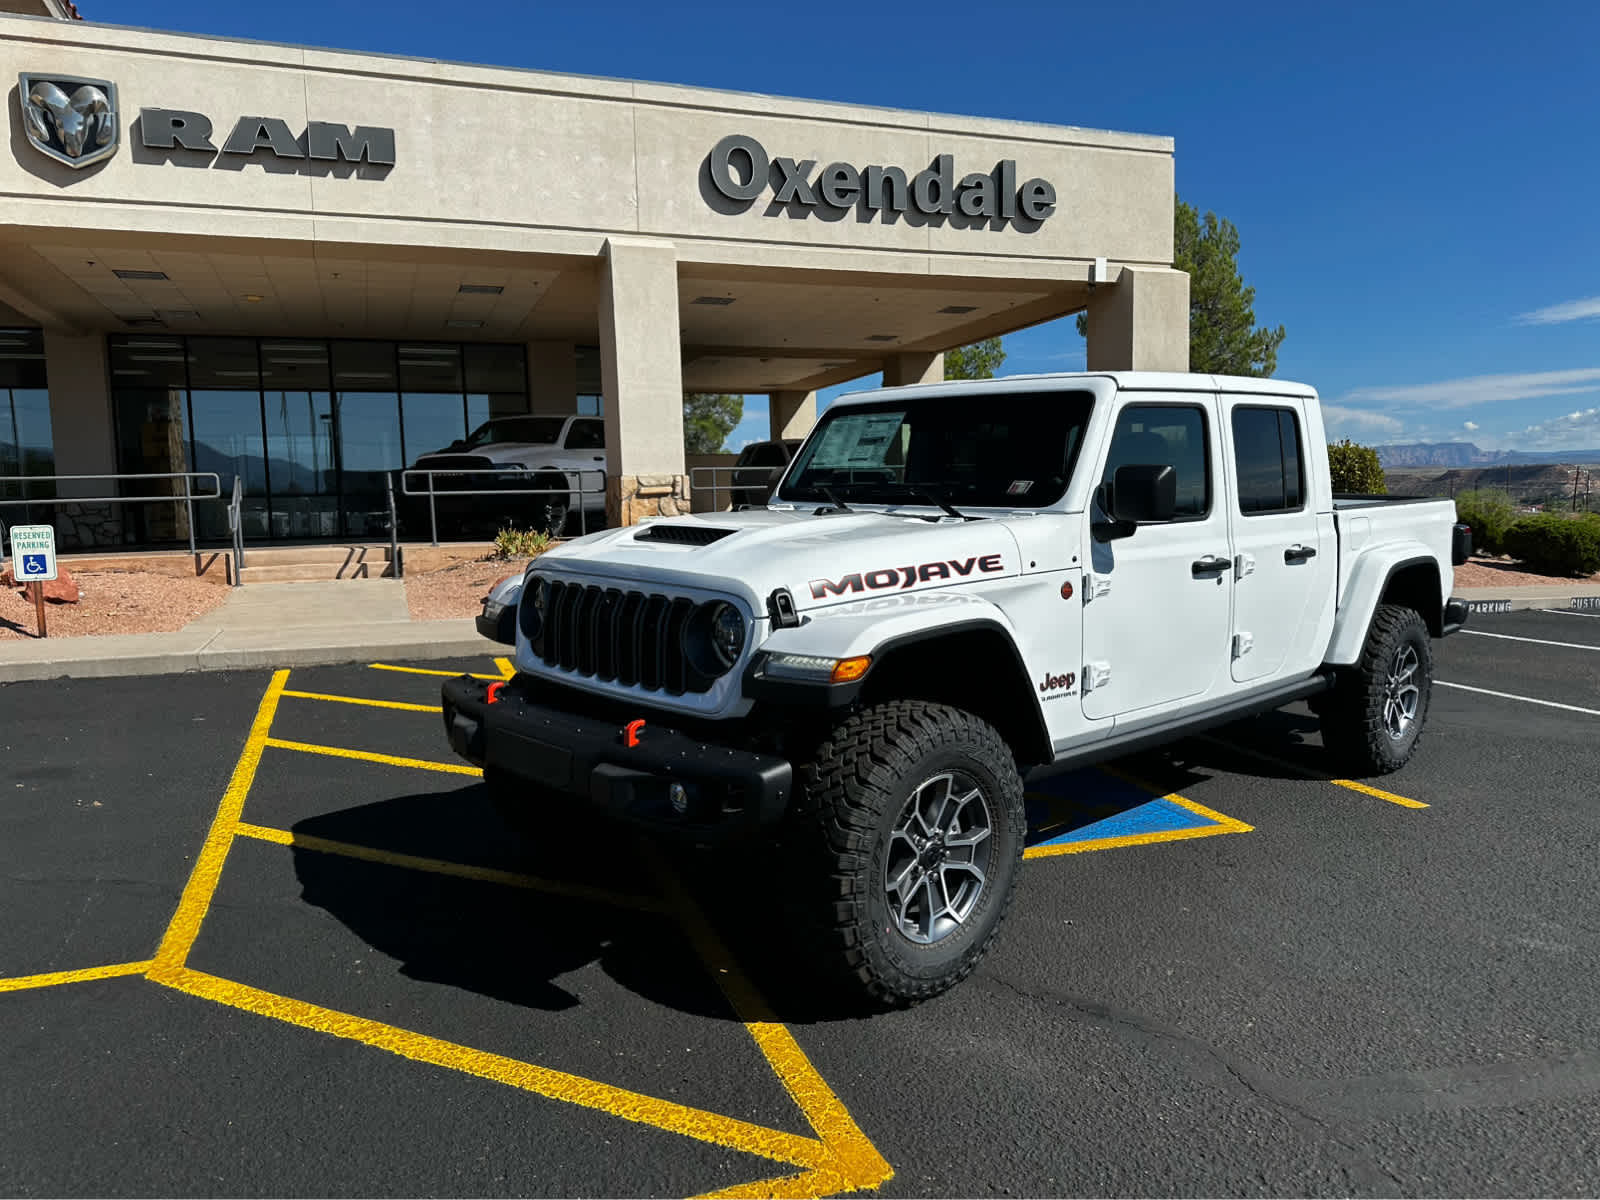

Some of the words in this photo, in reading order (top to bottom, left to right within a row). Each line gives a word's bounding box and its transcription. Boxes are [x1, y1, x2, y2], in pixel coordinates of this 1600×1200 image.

[140, 107, 395, 165] RAM
[710, 134, 1057, 220] Oxendale
[13, 531, 51, 540] RESERVED
[17, 541, 50, 550] PARKING
[808, 553, 1004, 600] MOJAVE
[1468, 602, 1512, 613] PARKING
[1039, 671, 1076, 692] Jeep
